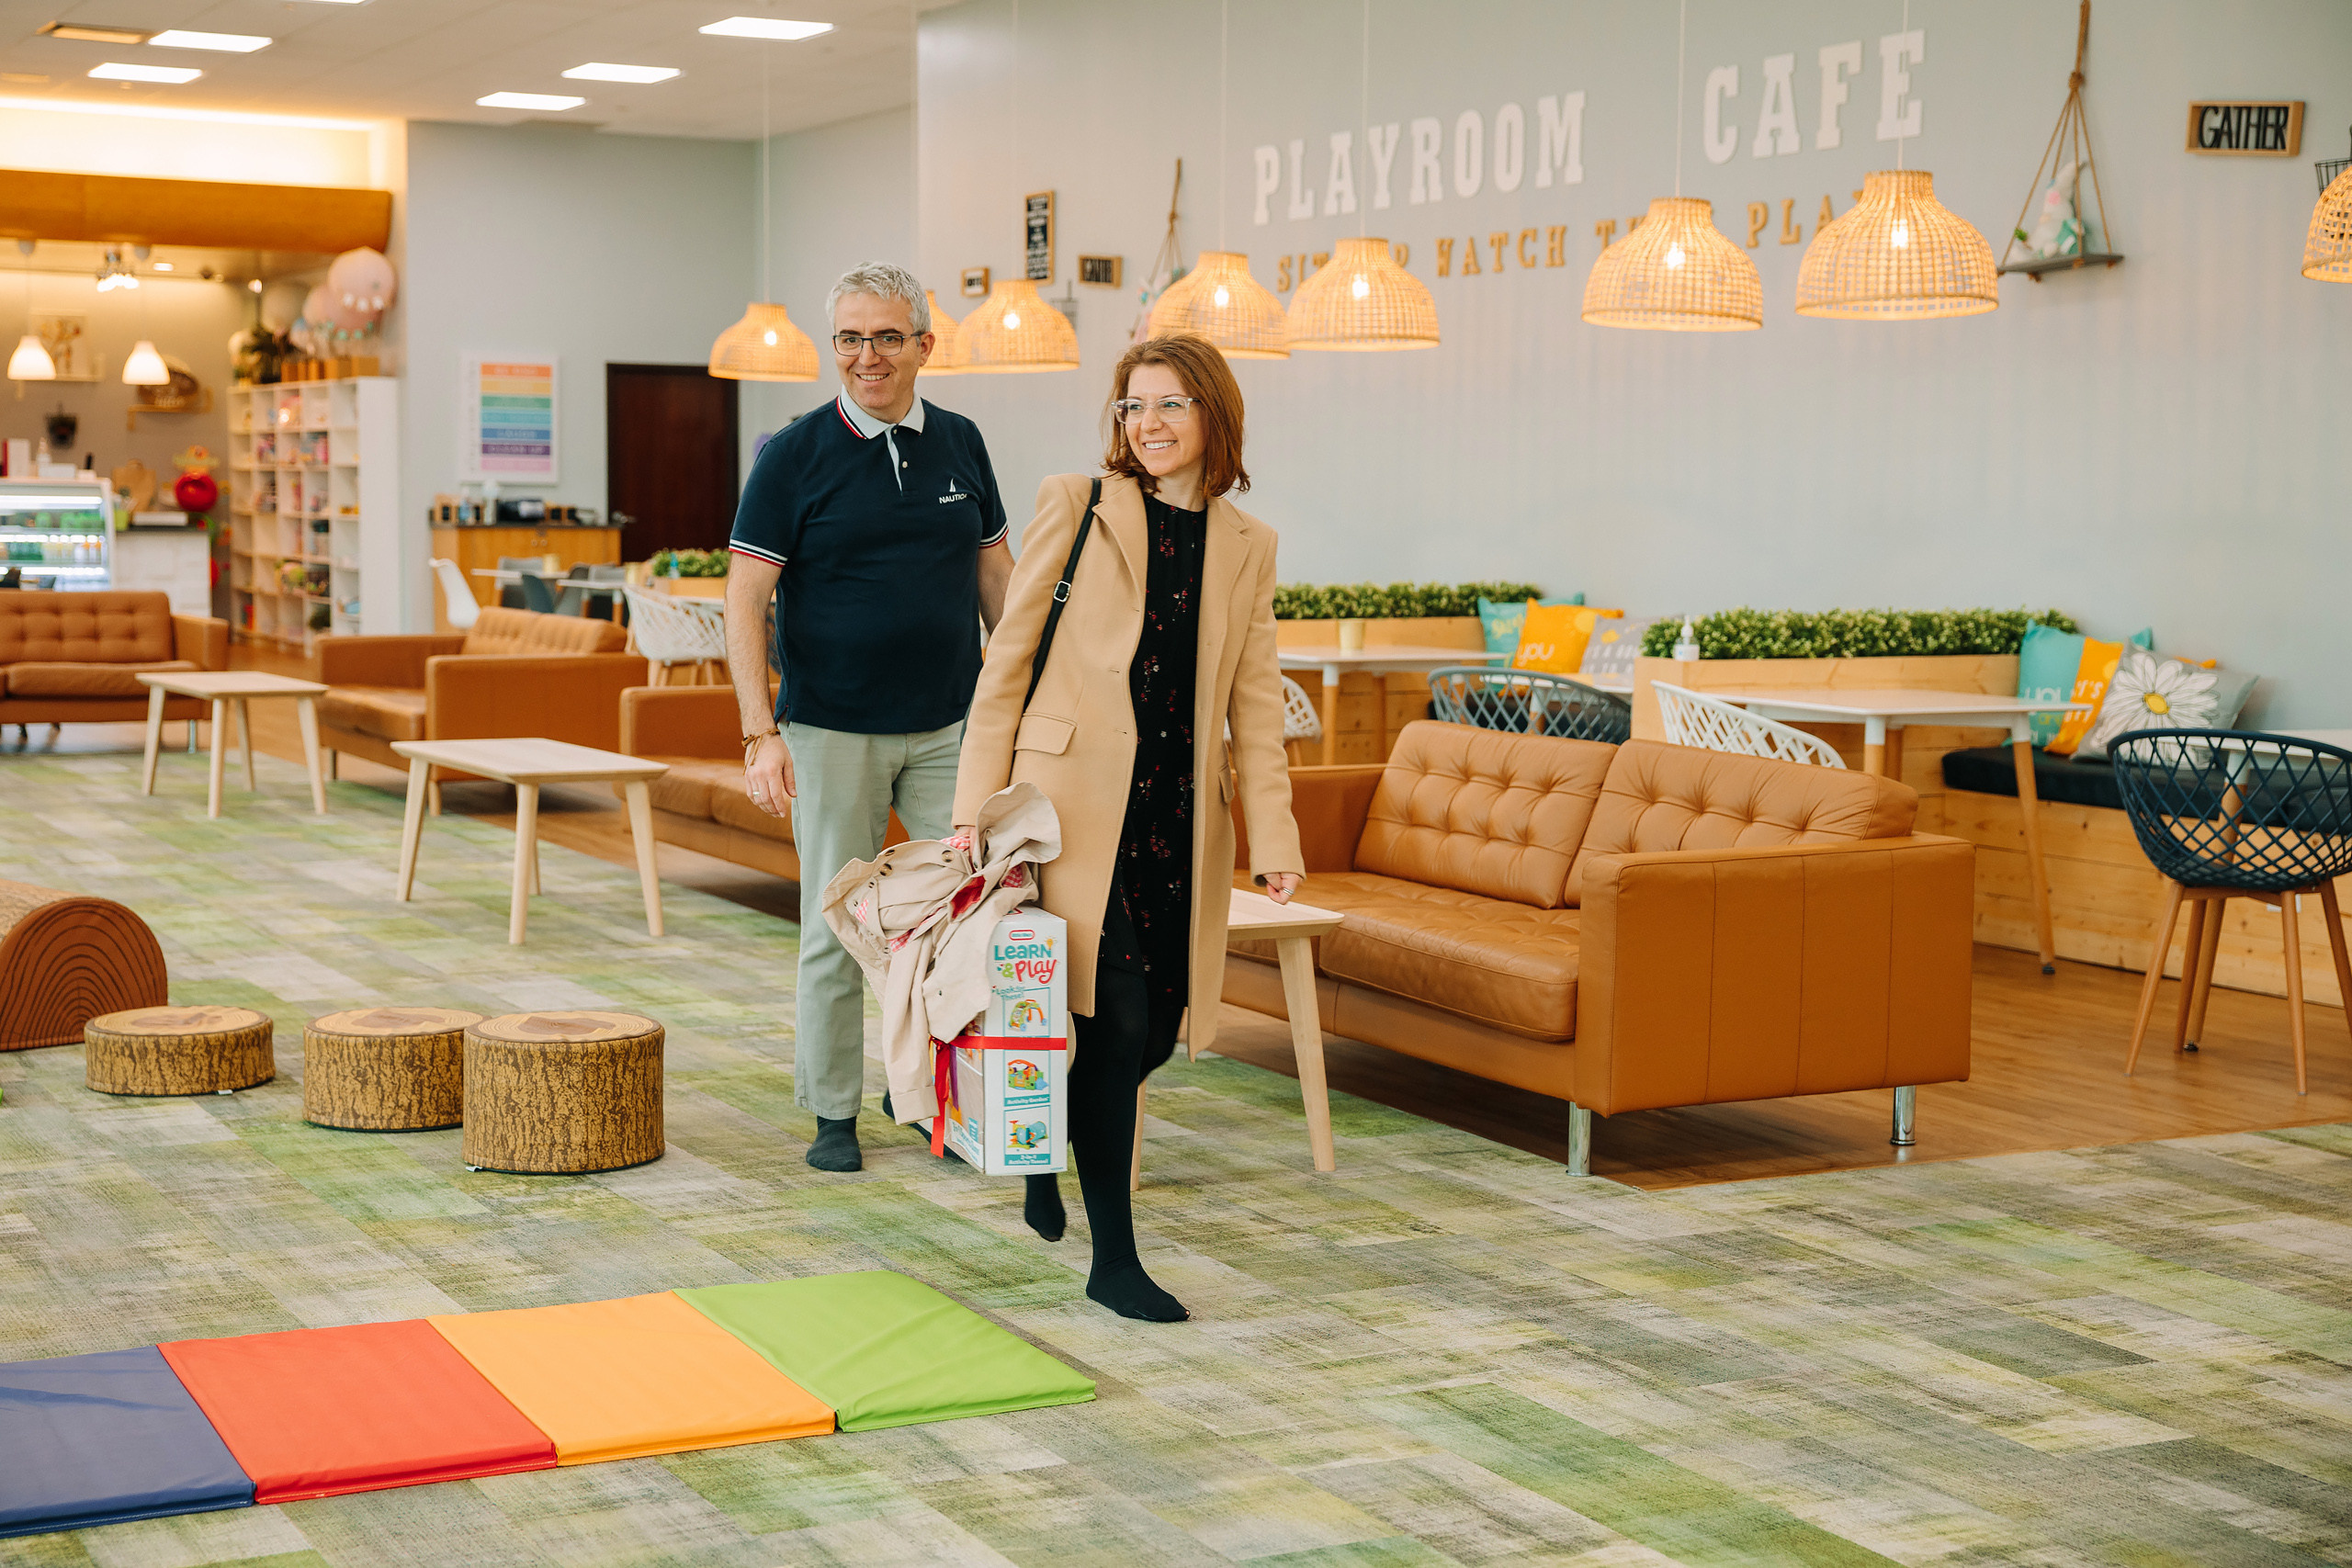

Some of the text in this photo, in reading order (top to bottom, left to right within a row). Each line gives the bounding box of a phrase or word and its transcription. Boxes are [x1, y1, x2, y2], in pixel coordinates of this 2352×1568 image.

[1253, 29, 1926, 225] PLAYROOM CAFE
[2199, 106, 2289, 150] GATHER
[1435, 225, 1567, 277] WATCH
[1746, 189, 1863, 249] PLA
[1001, 959, 1057, 984] & Play
